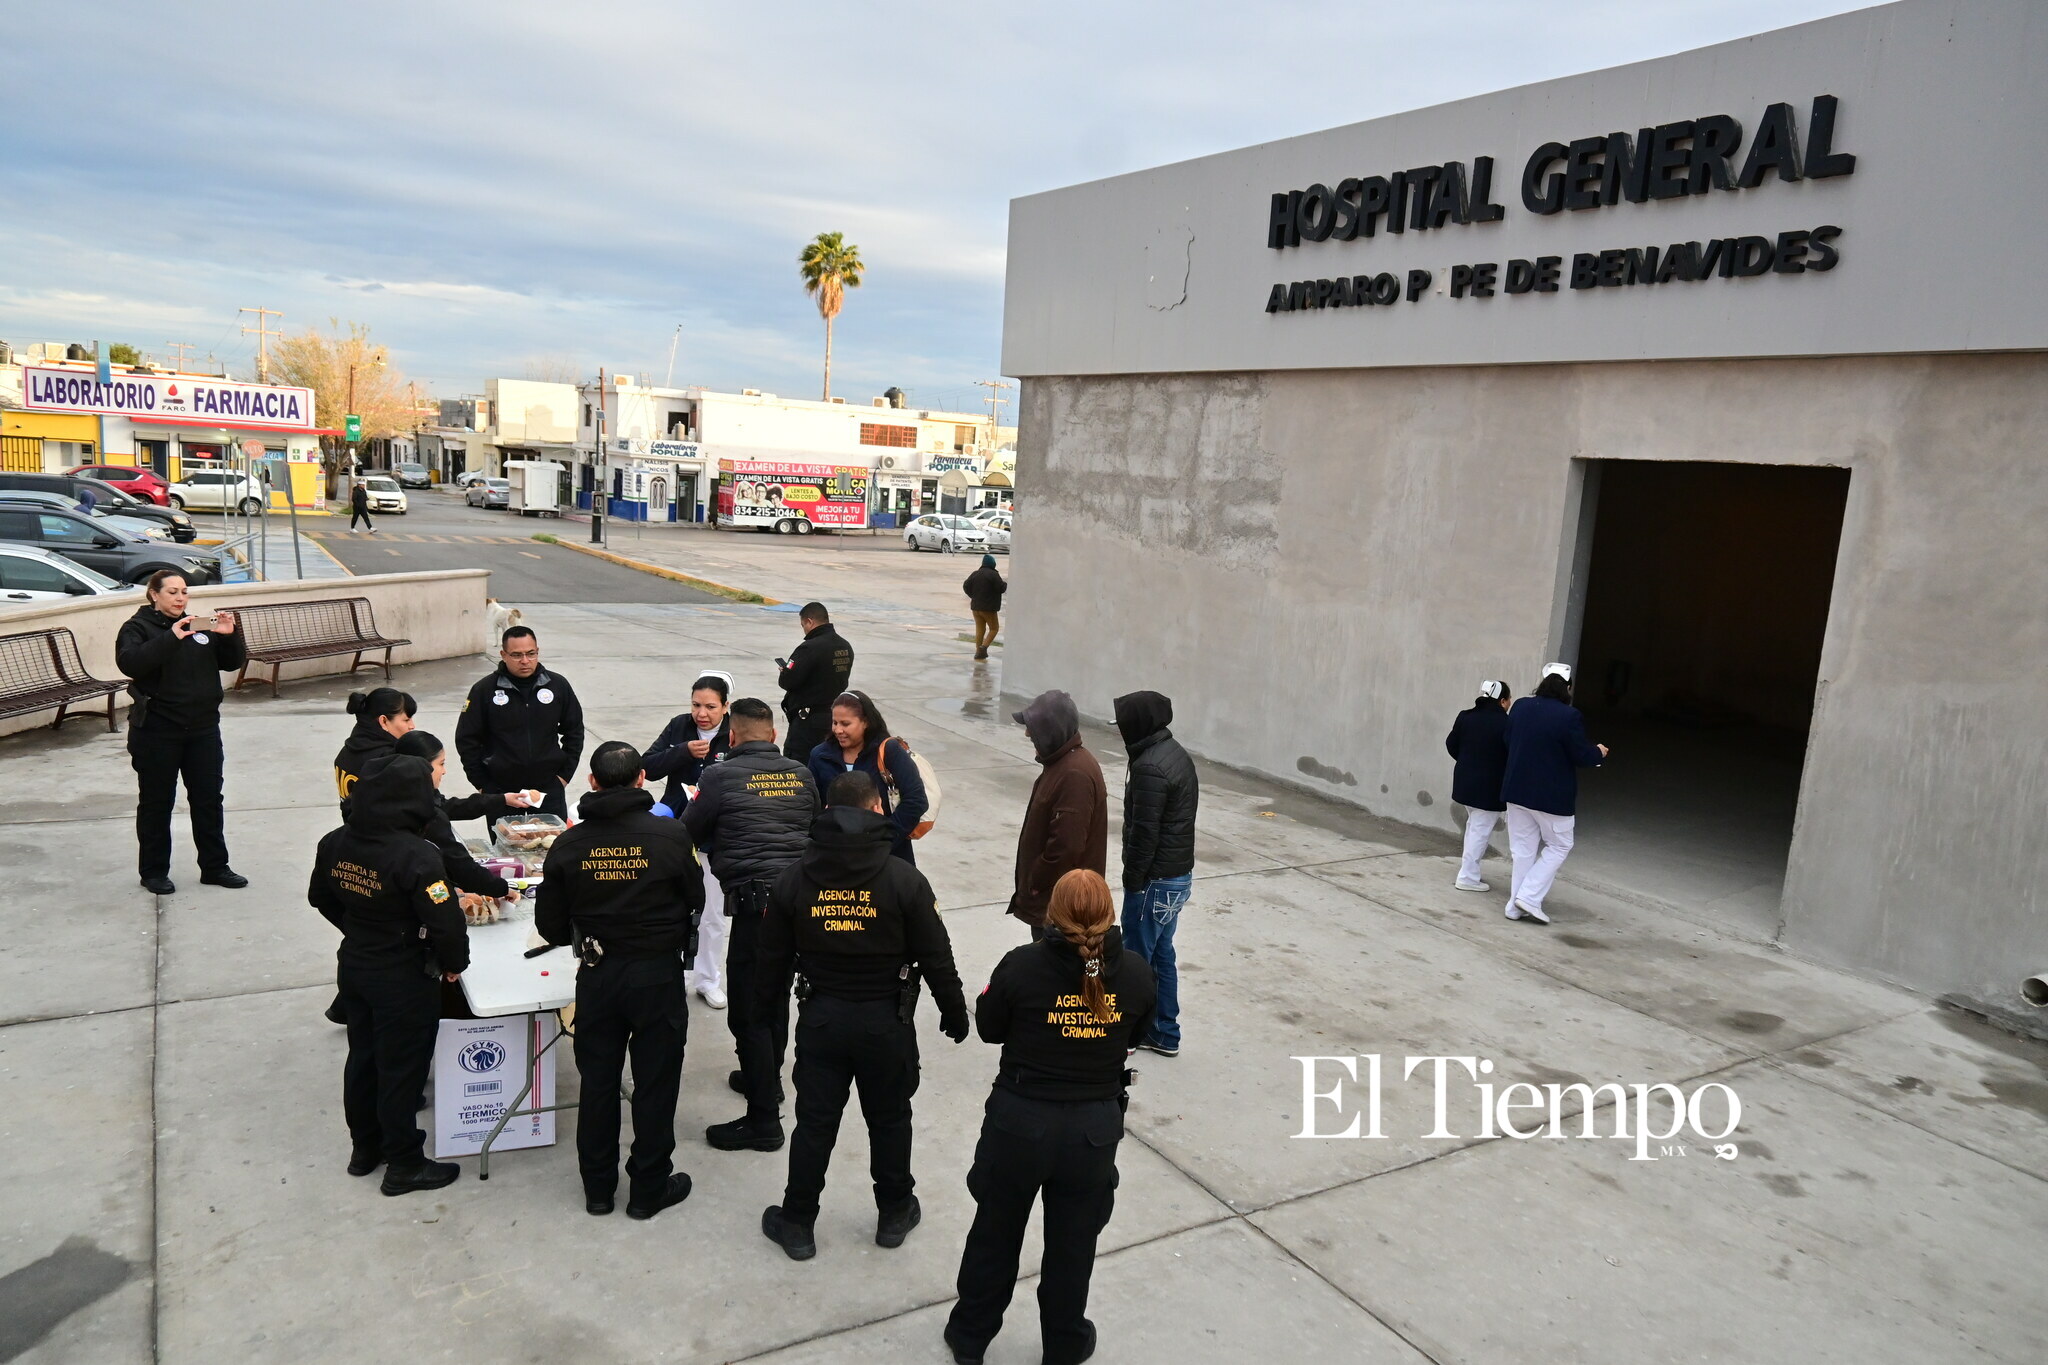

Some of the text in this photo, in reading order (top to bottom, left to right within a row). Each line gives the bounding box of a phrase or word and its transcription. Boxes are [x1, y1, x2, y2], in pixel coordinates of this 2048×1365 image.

[1267, 94, 1856, 250] HOSPITAL GENERAL
[1504, 256, 1562, 294] DE
[1569, 225, 1843, 290] BENAVIDES
[32, 375, 156, 410] LABORATORIO
[193, 387, 300, 420] FARMACIA
[651, 442, 697, 450] Laboratorio
[651, 449, 696, 457] POPULAR
[933, 454, 973, 465] Farmacia
[735, 461, 867, 477] EXAMEN DE LA VISTA GRATIS
[735, 474, 762, 482] EXAMEN
[783, 476, 800, 484] VISTA
[735, 506, 795, 517] 834-215-1046
[850, 506, 861, 514] TU
[818, 514, 839, 522] VISTA
[752, 772, 797, 781] AGENCIA DE
[759, 789, 796, 797] CRIMINAL
[589, 846, 642, 858] AGENCIA DE
[581, 857, 649, 870] INVESTIGACIÓN
[337, 861, 378, 880] AGENCIA DE
[594, 870, 638, 880] CRIMINAL
[340, 880, 372, 898] CRIMINAL
[818, 890, 871, 902] AGENCIA DE
[811, 903, 877, 918] INVESTIGACIÓN
[824, 920, 866, 932] CRIMINAL
[1104, 994, 1117, 1006] DE
[1061, 1026, 1107, 1039] CRIMINAL
[466, 1042, 500, 1054] REYMA
[458, 1108, 507, 1119] TERMICO
[463, 1104, 483, 1112] VASO
